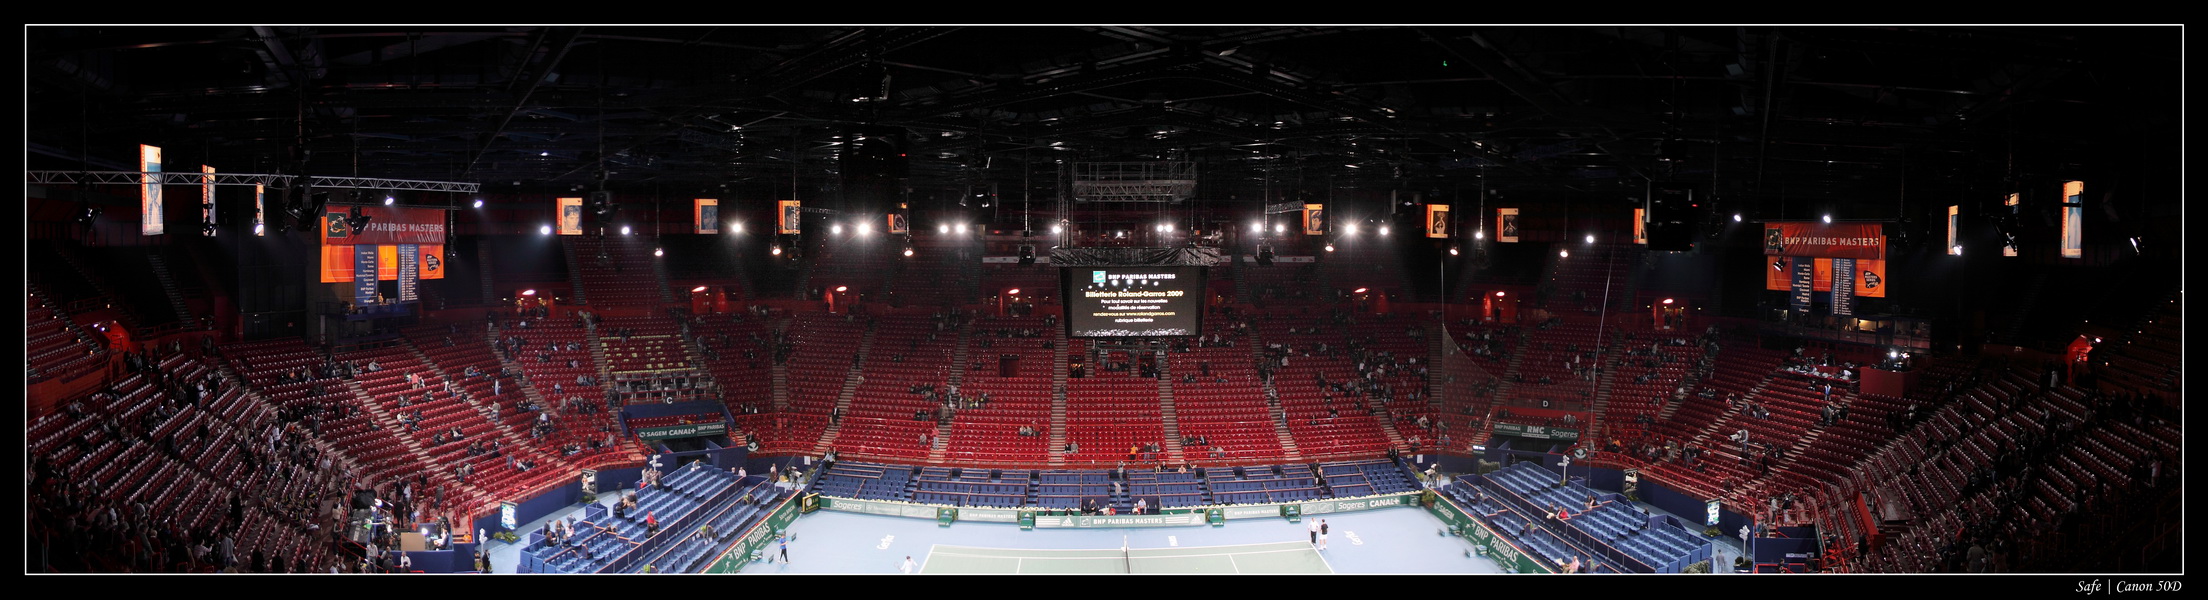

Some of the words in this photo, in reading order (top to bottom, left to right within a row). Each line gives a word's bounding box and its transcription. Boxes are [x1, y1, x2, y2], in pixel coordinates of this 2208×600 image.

[371, 224, 406, 232] PARIBAS
[1802, 237, 1836, 245] PARIBAS
[1840, 238, 1879, 246] MASTERS
[669, 428, 696, 436] CANAL+
[1527, 426, 1545, 434] RMC
[1551, 429, 1578, 438] Sogeres
[834, 500, 862, 510] Sogeres
[1338, 502, 1365, 510] Sogeres
[1370, 498, 1400, 508] CANAL+
[1438, 504, 1455, 520] SAGEM
[733, 542, 746, 560] BNP
[748, 522, 771, 546] PARIBAS
[1475, 525, 1488, 541] BNP
[1490, 536, 1518, 563] PARIBAS
